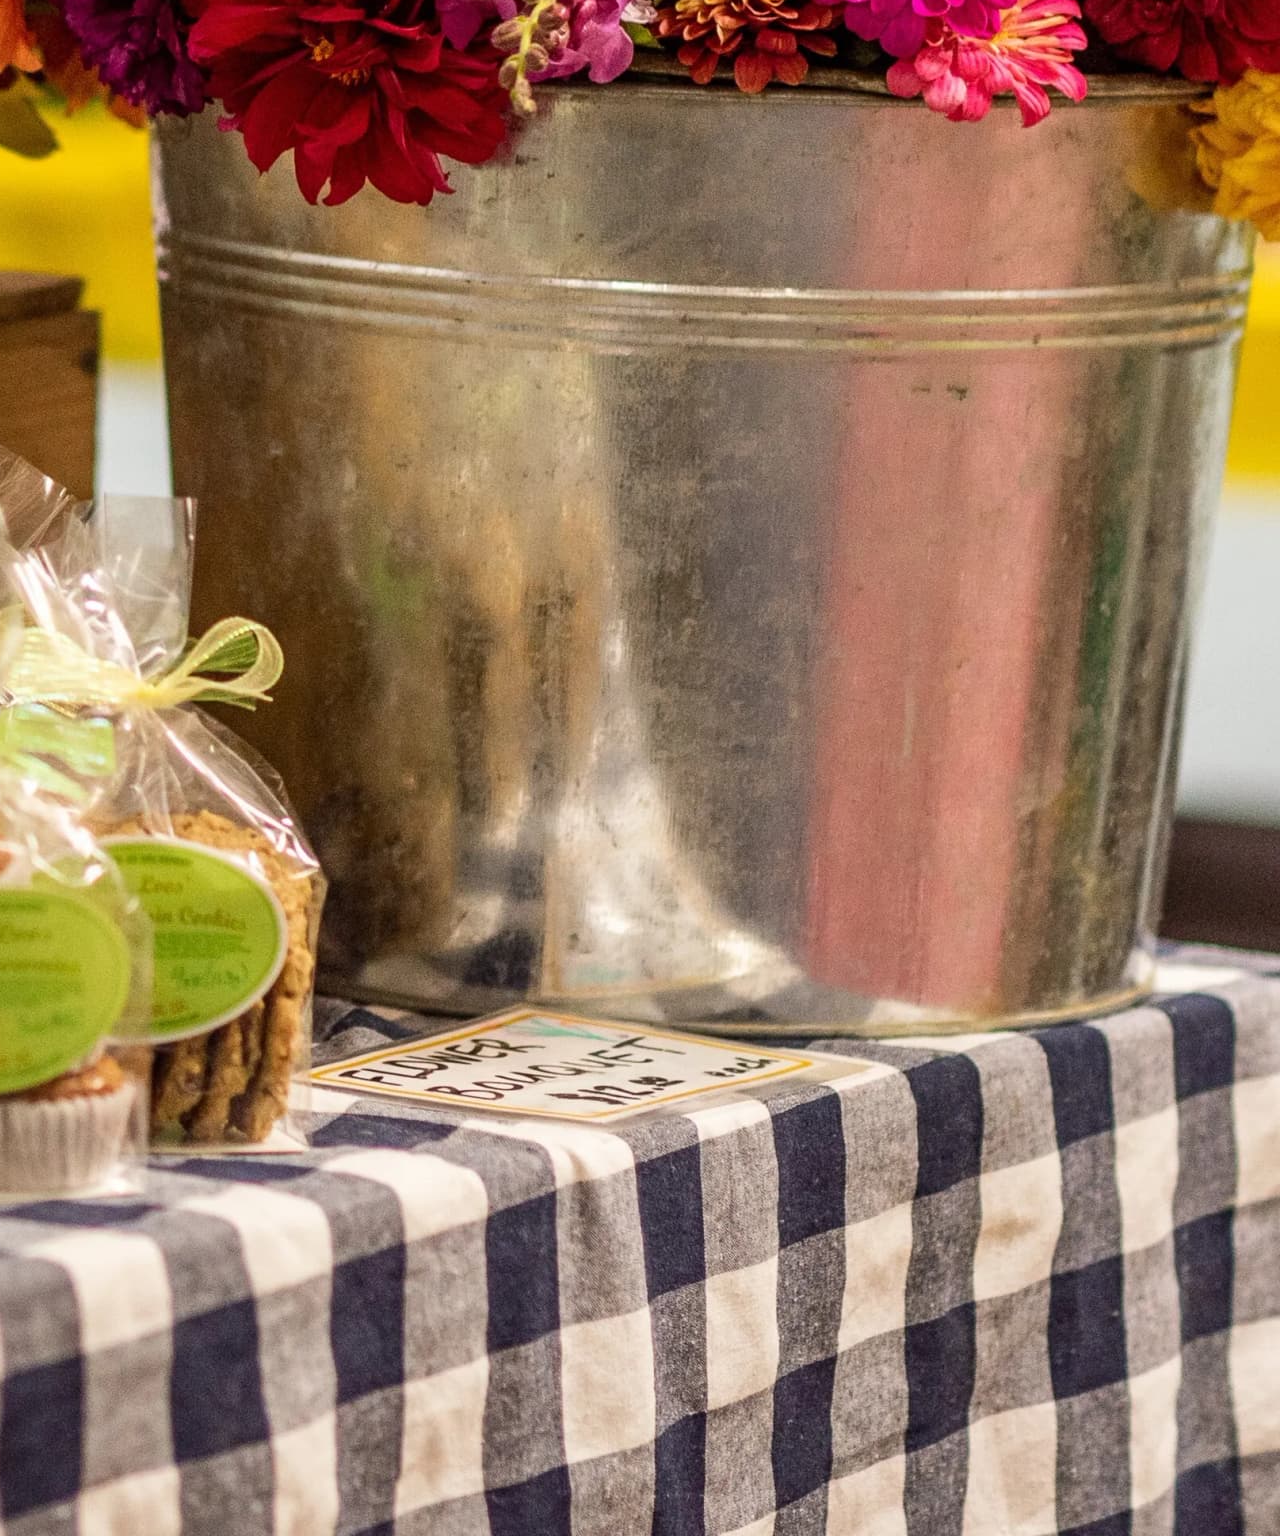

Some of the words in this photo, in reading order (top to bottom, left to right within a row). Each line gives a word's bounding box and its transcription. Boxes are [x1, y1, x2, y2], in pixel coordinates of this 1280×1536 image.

[338, 1037, 546, 1086] FLOWER
[425, 1035, 686, 1101] BOUQUET
[703, 1056, 781, 1080] each
